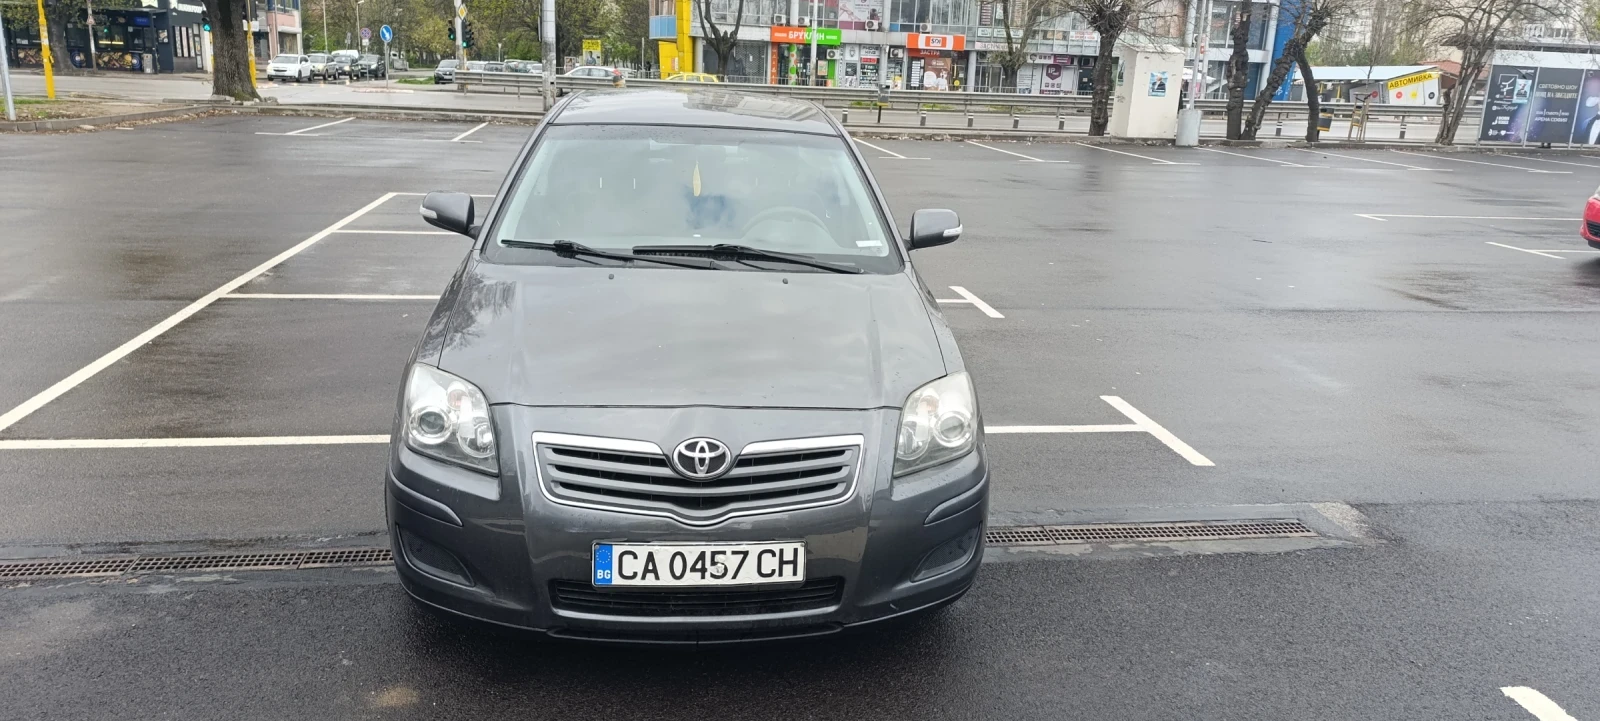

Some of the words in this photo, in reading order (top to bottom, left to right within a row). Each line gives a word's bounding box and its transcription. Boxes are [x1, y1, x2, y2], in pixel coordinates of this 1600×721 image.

[1389, 73, 1432, 88] АВТОМИВКА
[617, 550, 660, 581] CA
[668, 550, 749, 580] 0457
[757, 547, 799, 578] CH
[597, 569, 611, 580] BG
